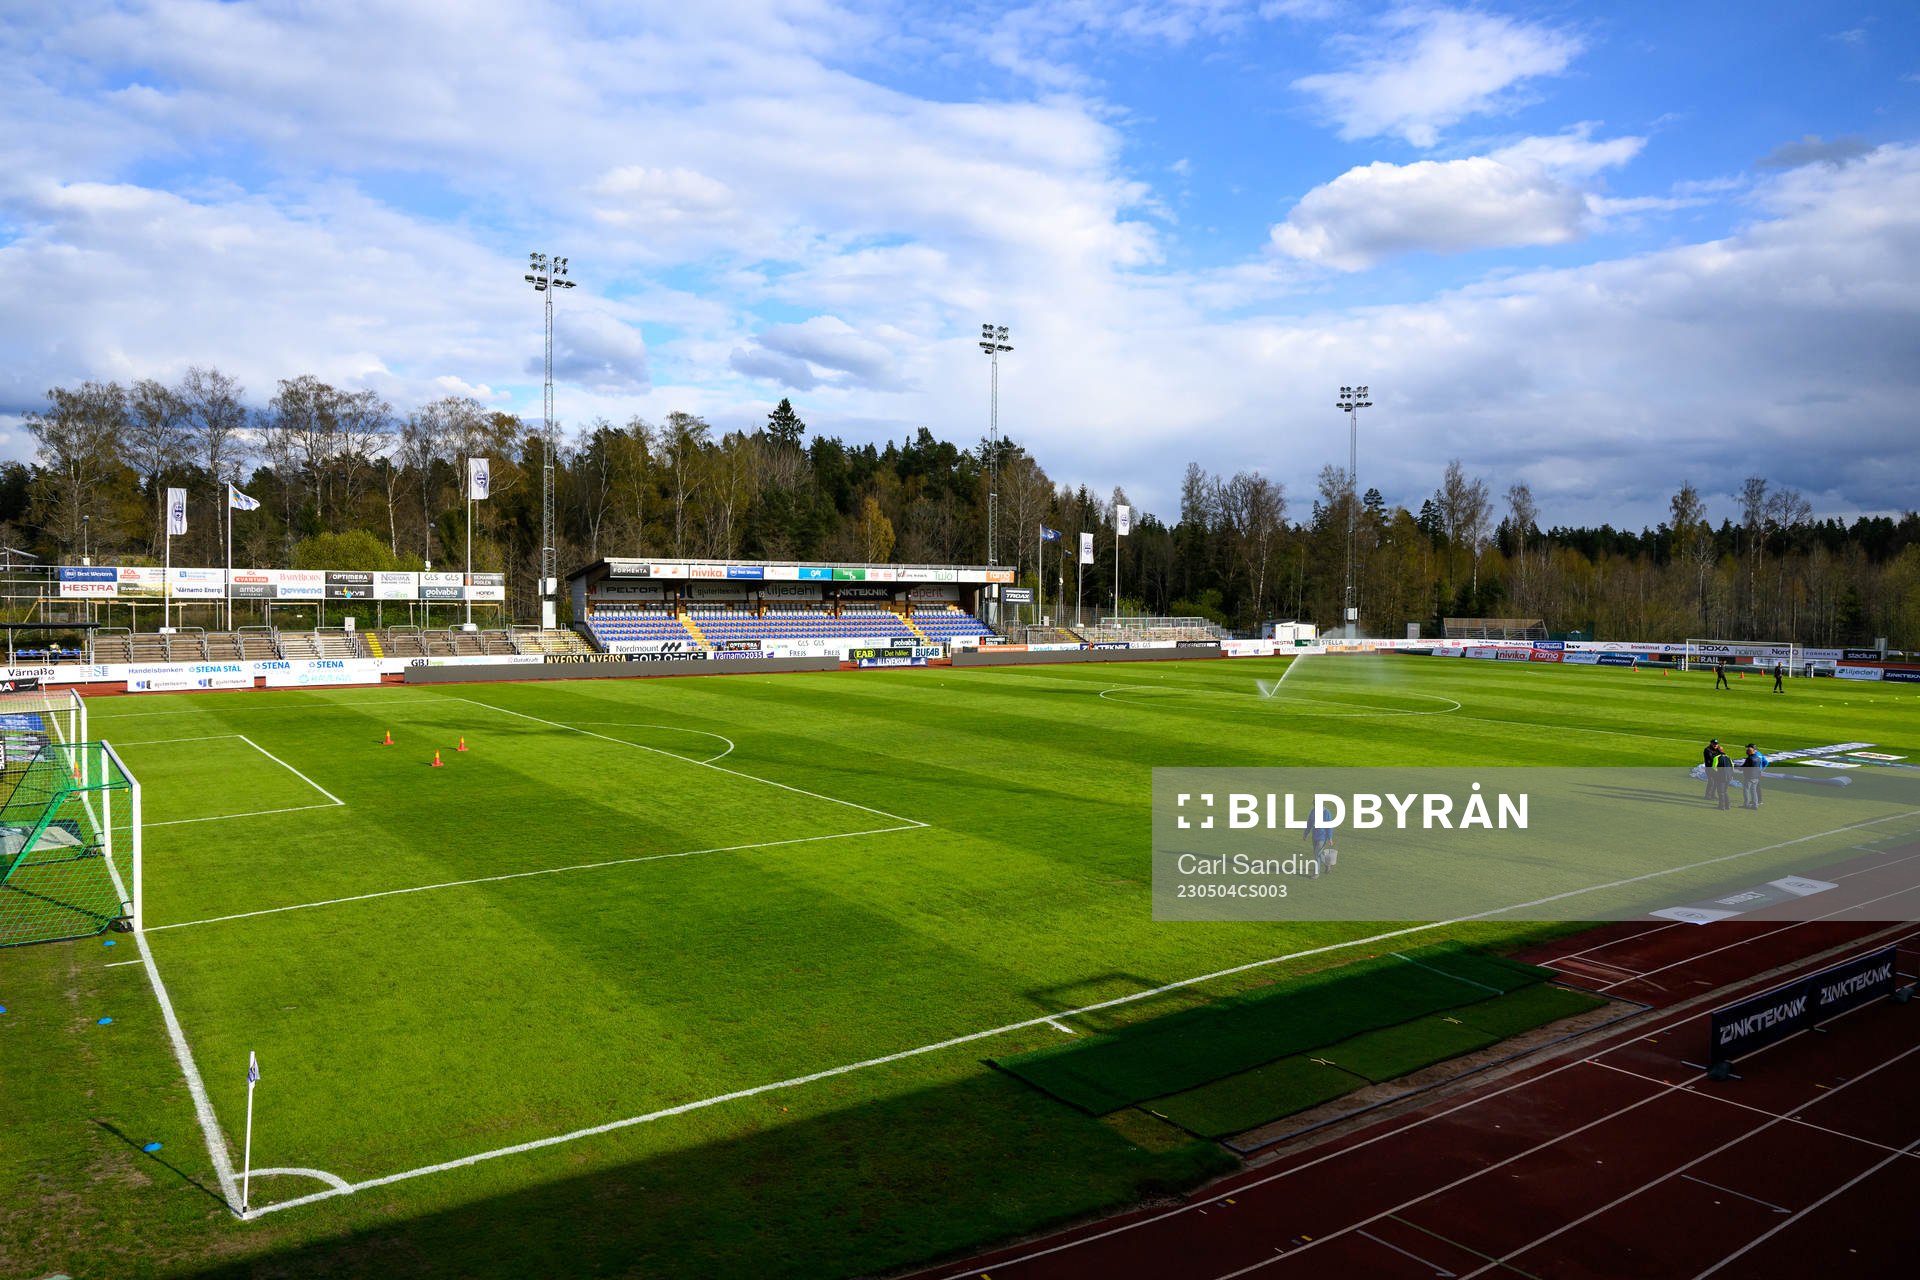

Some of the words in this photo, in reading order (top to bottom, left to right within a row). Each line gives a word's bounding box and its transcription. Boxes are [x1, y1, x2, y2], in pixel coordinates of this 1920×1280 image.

[692, 569, 726, 577] nivika.
[62, 584, 115, 592] HESTRA
[204, 587, 223, 595] Energi
[767, 584, 815, 597] Liljedahl
[426, 588, 459, 598] golvabia
[615, 643, 660, 652] Nordmount
[714, 650, 764, 660] Värnamo2035
[856, 650, 875, 659] EAB
[915, 648, 940, 657] BUFAB
[1499, 651, 1528, 660] nivika.
[1848, 652, 1878, 660] stadium
[546, 655, 585, 664] NYFOSA
[589, 655, 627, 663] NYFOSA
[877, 656, 911, 665] ALLSVENSKAN
[1671, 655, 1719, 664] SARTRAIL
[261, 661, 291, 670] STENA
[8, 667, 55, 677] VärnaBo
[128, 667, 184, 675] Handelsbanken
[1820, 963, 1892, 1005] ZINKTEKNIK
[1719, 995, 1808, 1046] ZINKTEKNIK
